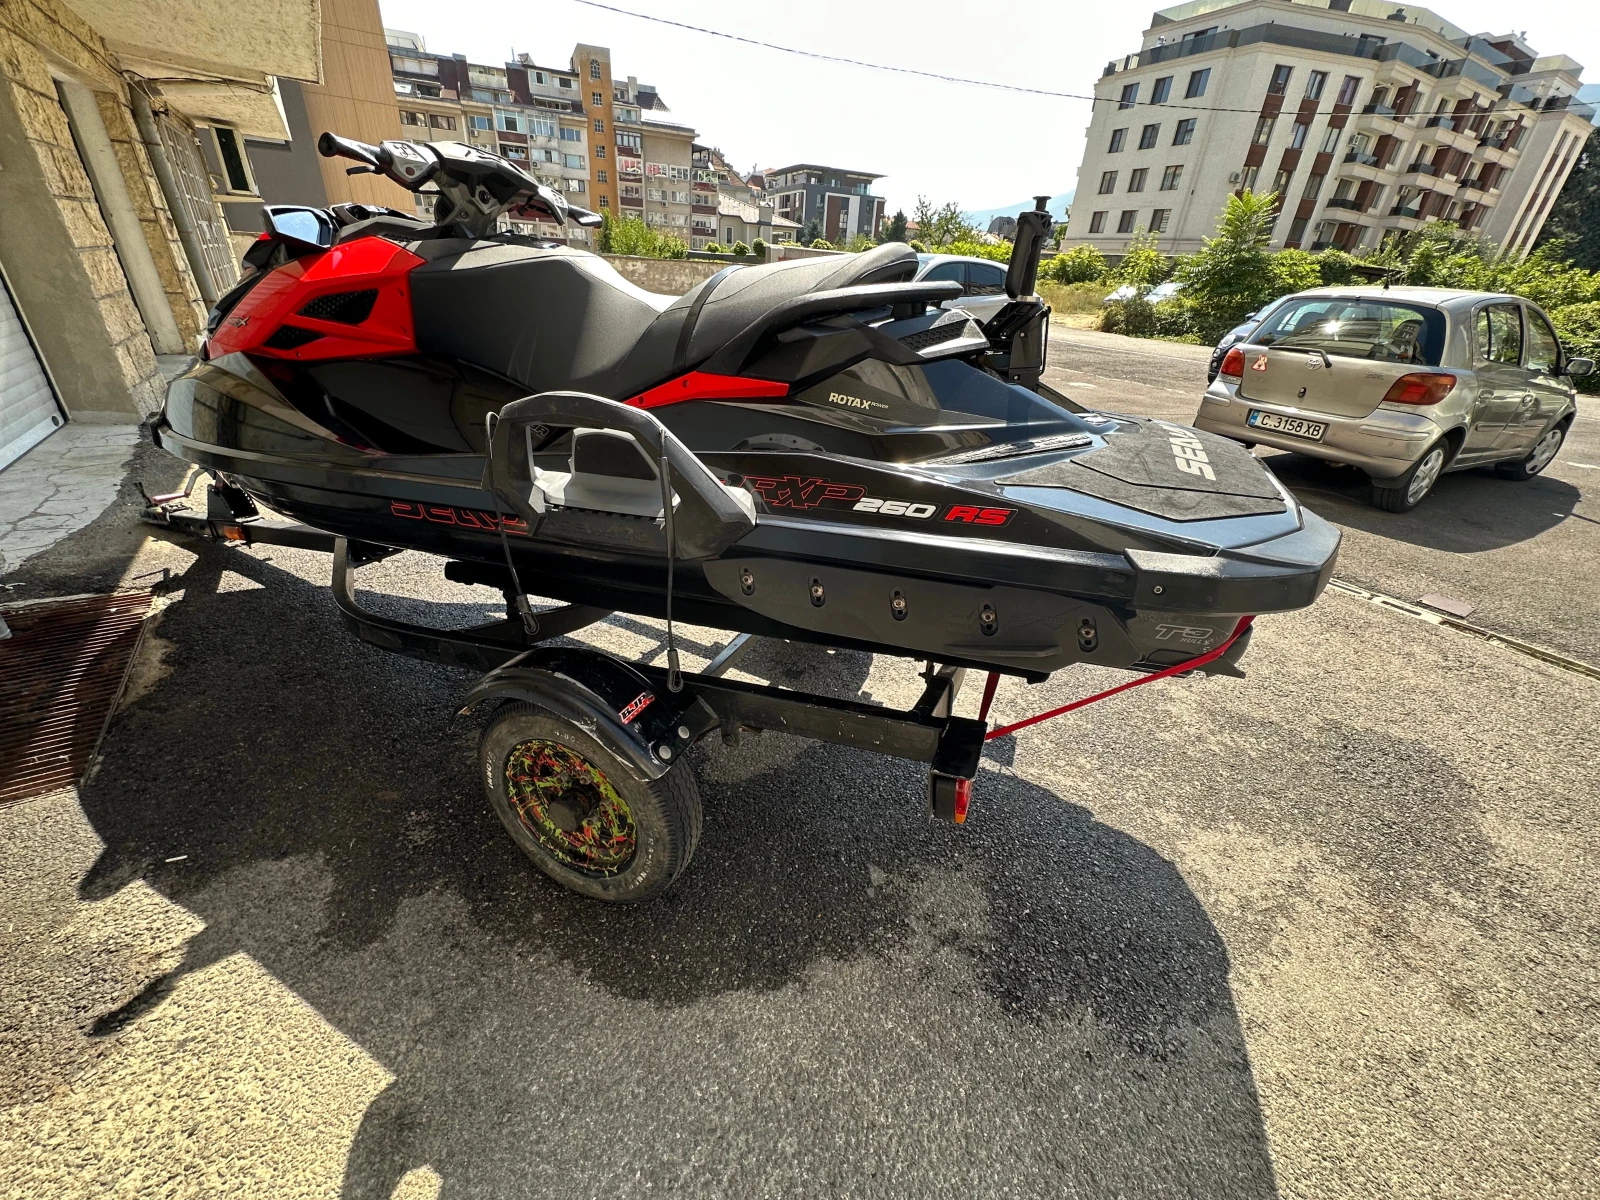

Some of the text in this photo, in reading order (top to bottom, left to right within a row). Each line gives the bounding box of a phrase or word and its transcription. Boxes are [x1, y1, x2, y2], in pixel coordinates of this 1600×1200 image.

[828, 392, 871, 409] ROTAX
[852, 497, 937, 519] 260
[944, 505, 1011, 526] RS
[1155, 623, 1213, 640] T3
